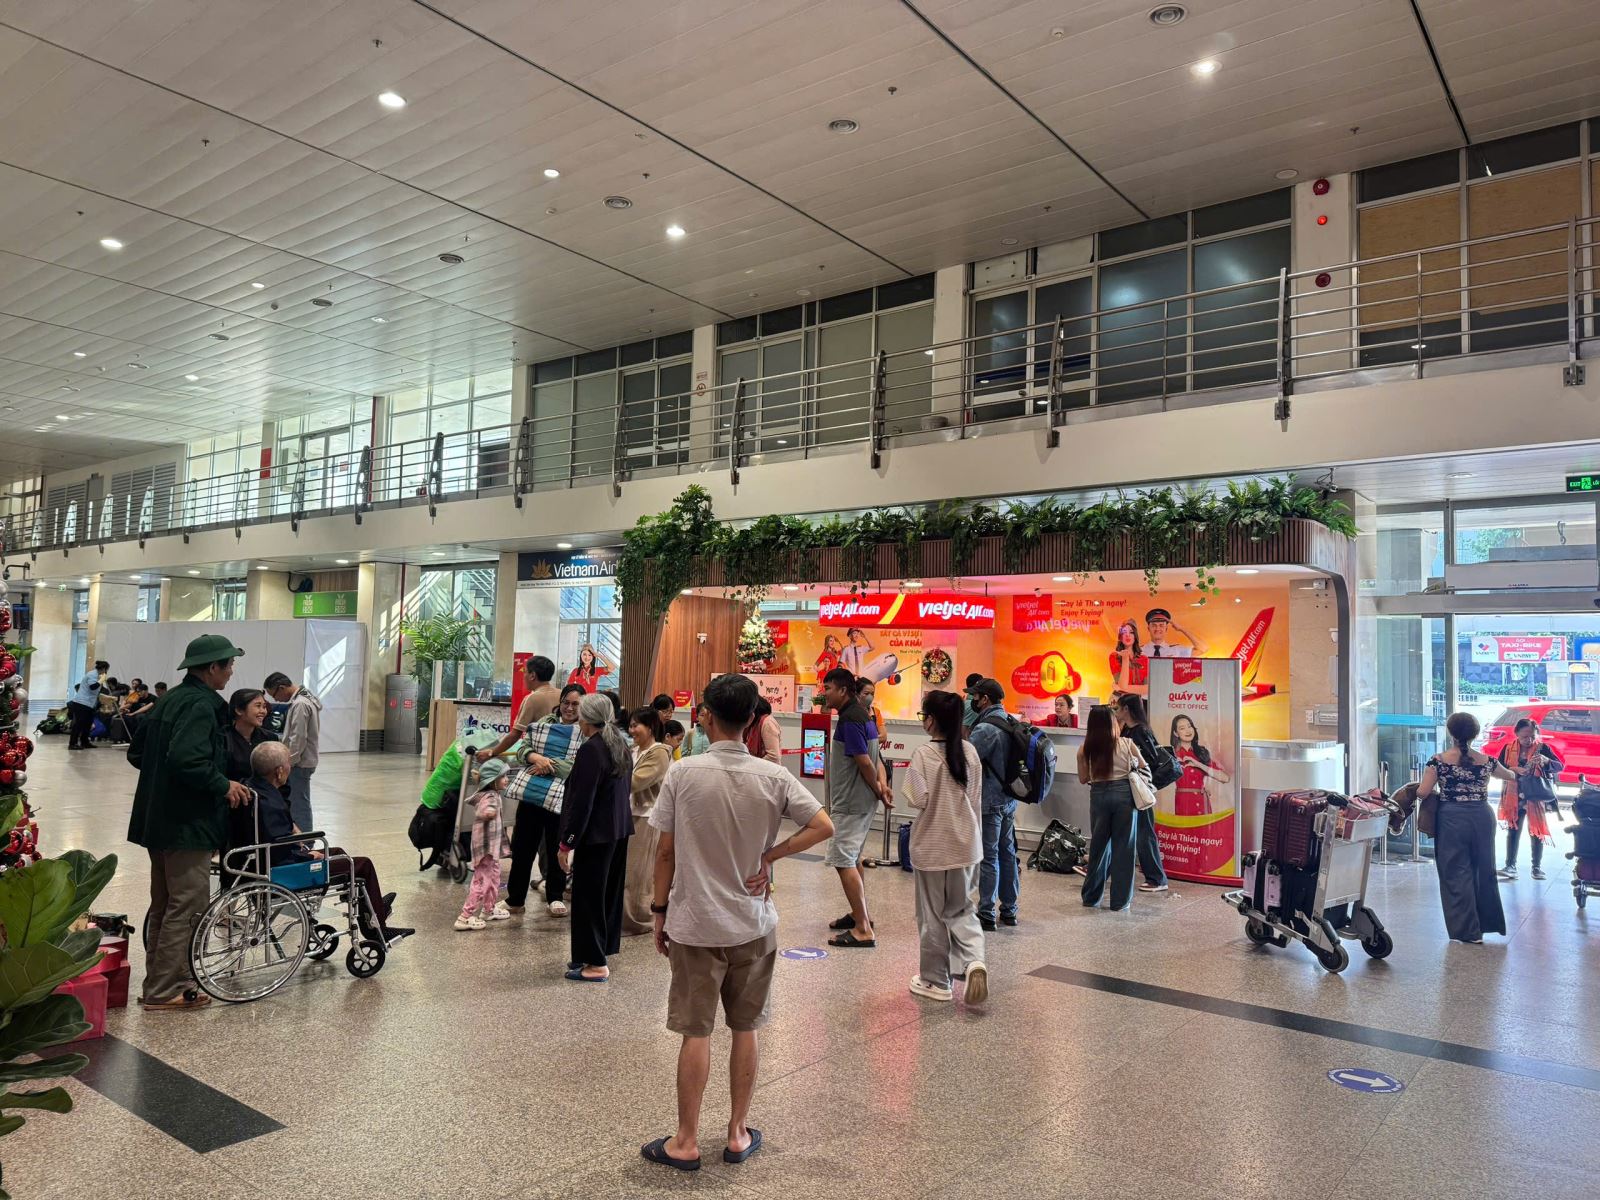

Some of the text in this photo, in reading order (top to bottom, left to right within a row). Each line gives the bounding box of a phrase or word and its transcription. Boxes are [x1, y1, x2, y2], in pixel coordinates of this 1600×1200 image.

[553, 563, 599, 578] Vietnam
[1158, 830, 1170, 840] Bay
[1200, 838, 1223, 847] ngay!
[1158, 840, 1201, 855] Enjoy Flying!
